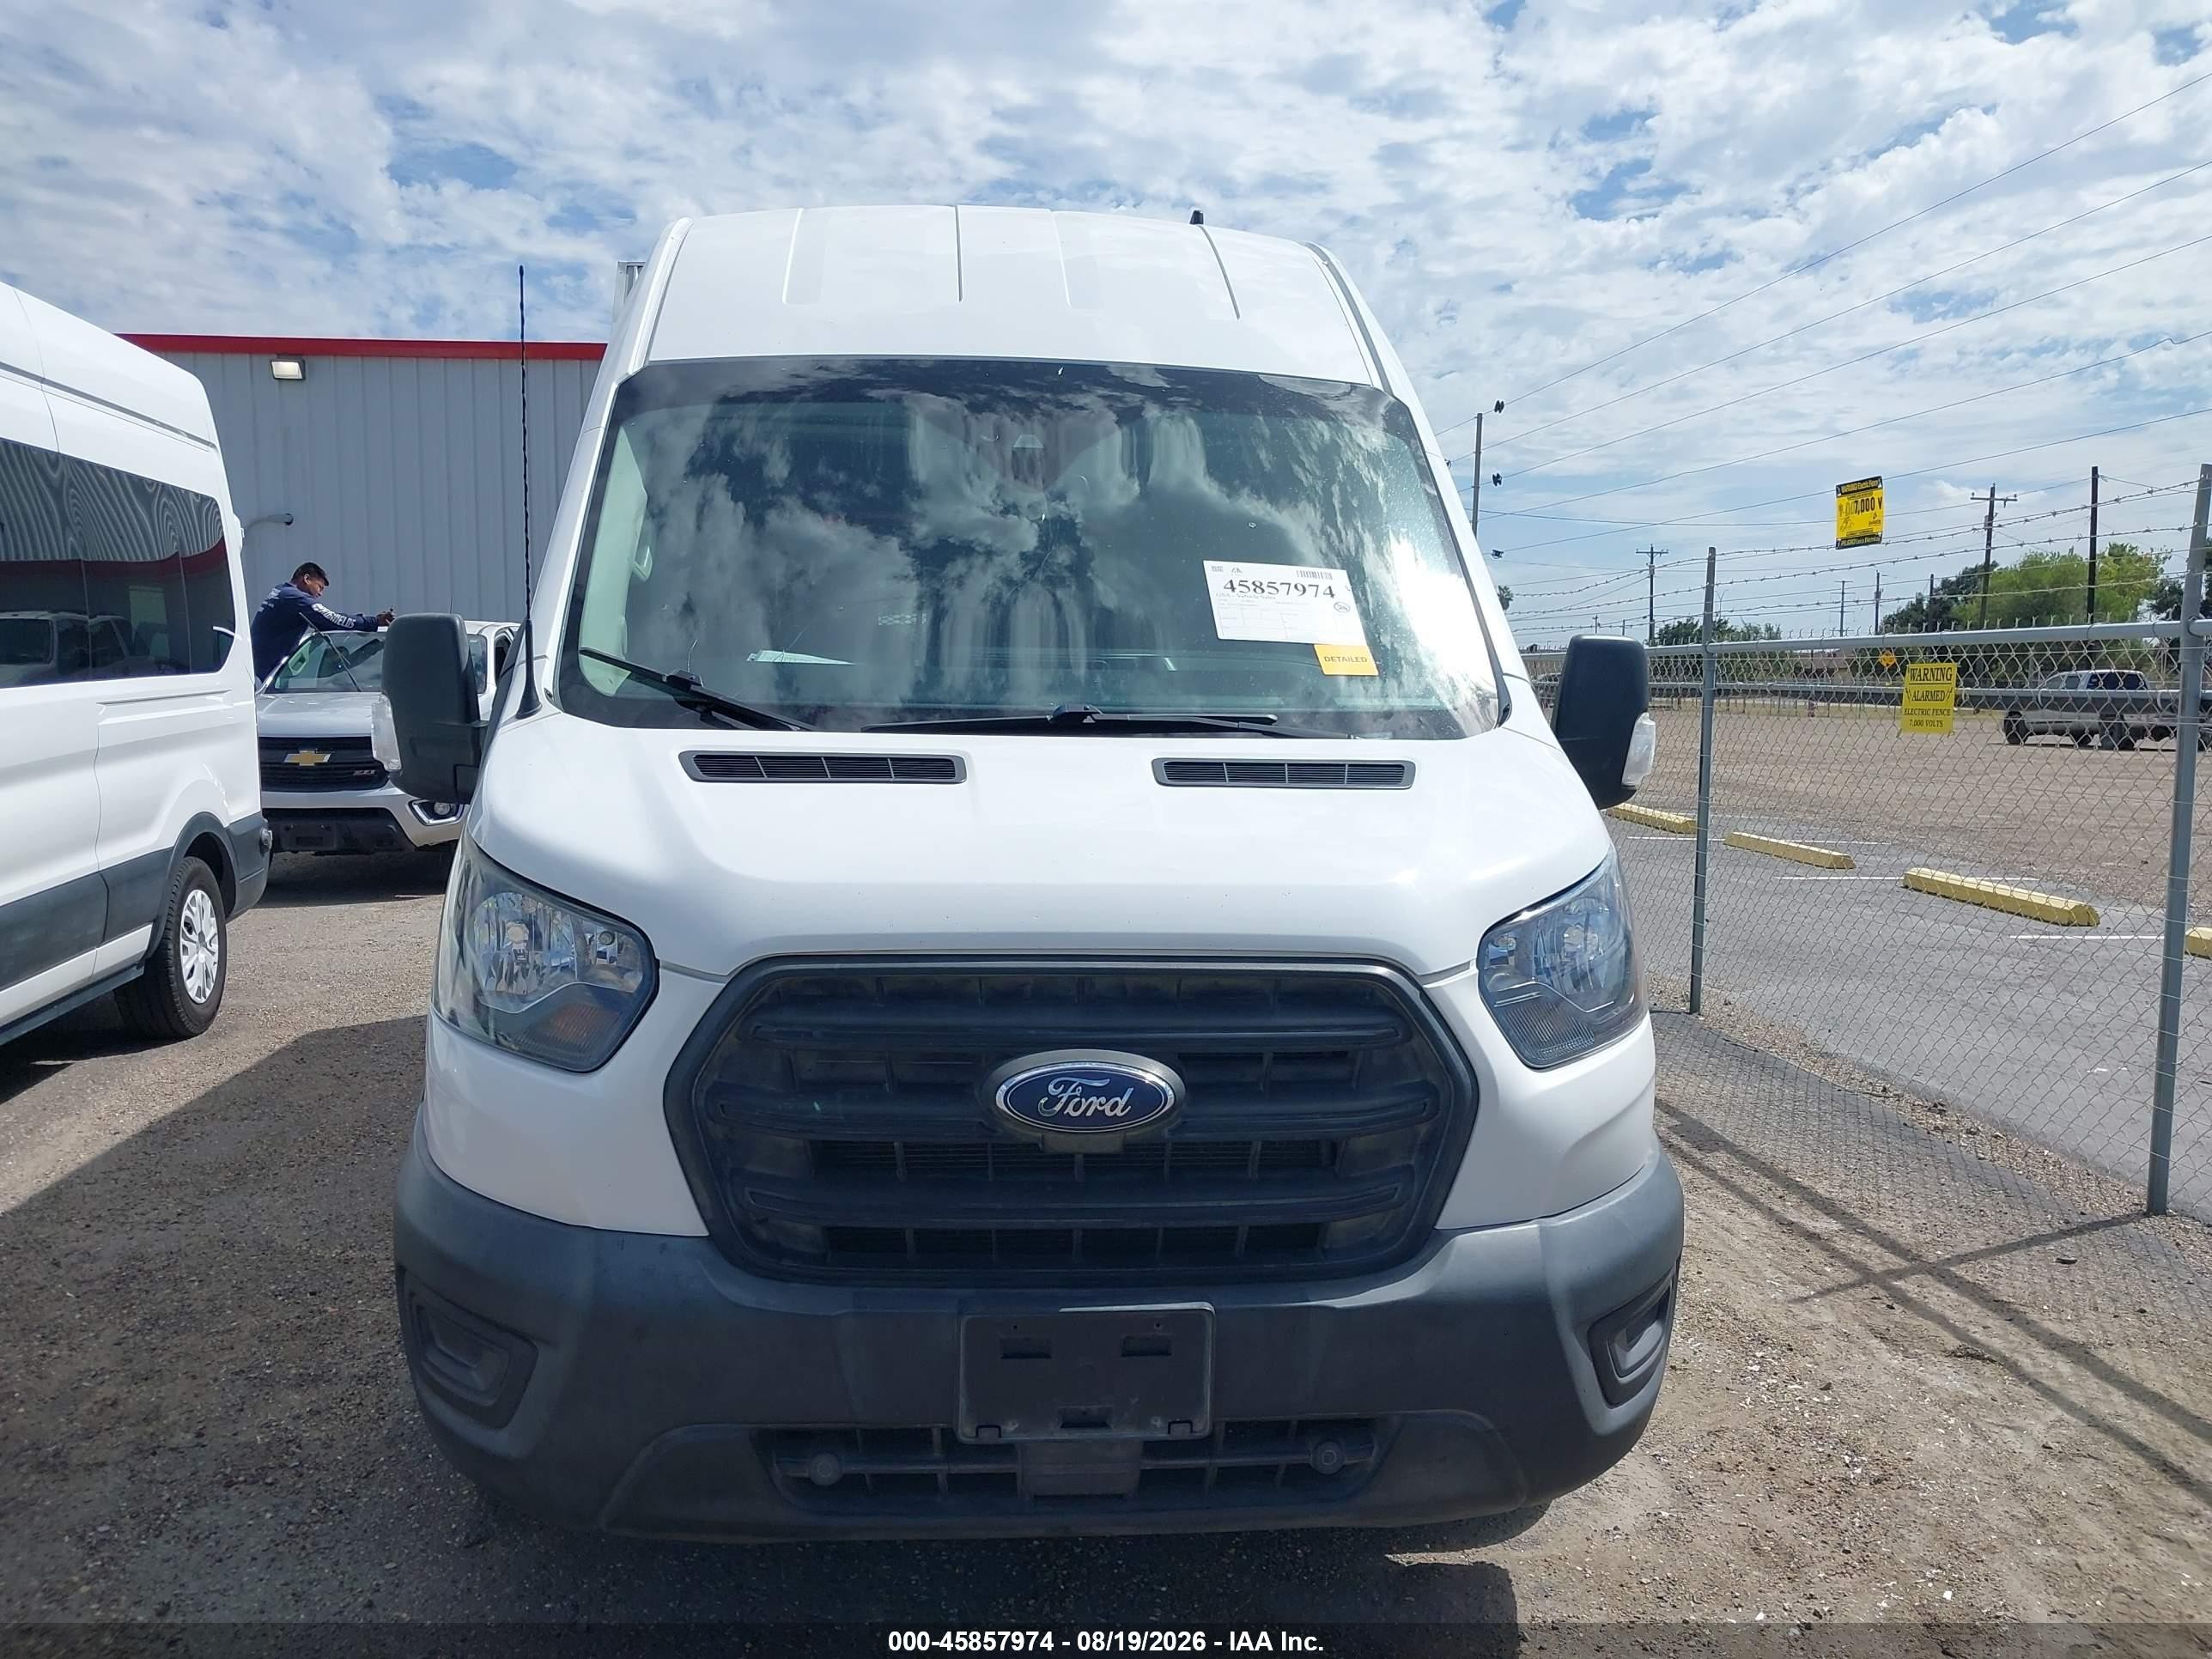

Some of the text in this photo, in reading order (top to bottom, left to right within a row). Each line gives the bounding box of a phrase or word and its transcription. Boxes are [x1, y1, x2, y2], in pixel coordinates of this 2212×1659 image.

[1855, 496, 1882, 515] 7,000 V
[1224, 579, 1335, 599] 45857974
[1324, 655, 1368, 664] DETAILED
[1911, 668, 1952, 681] WARNING
[1911, 690, 1945, 701] ALARMED
[1037, 1077, 1134, 1117] Ford
